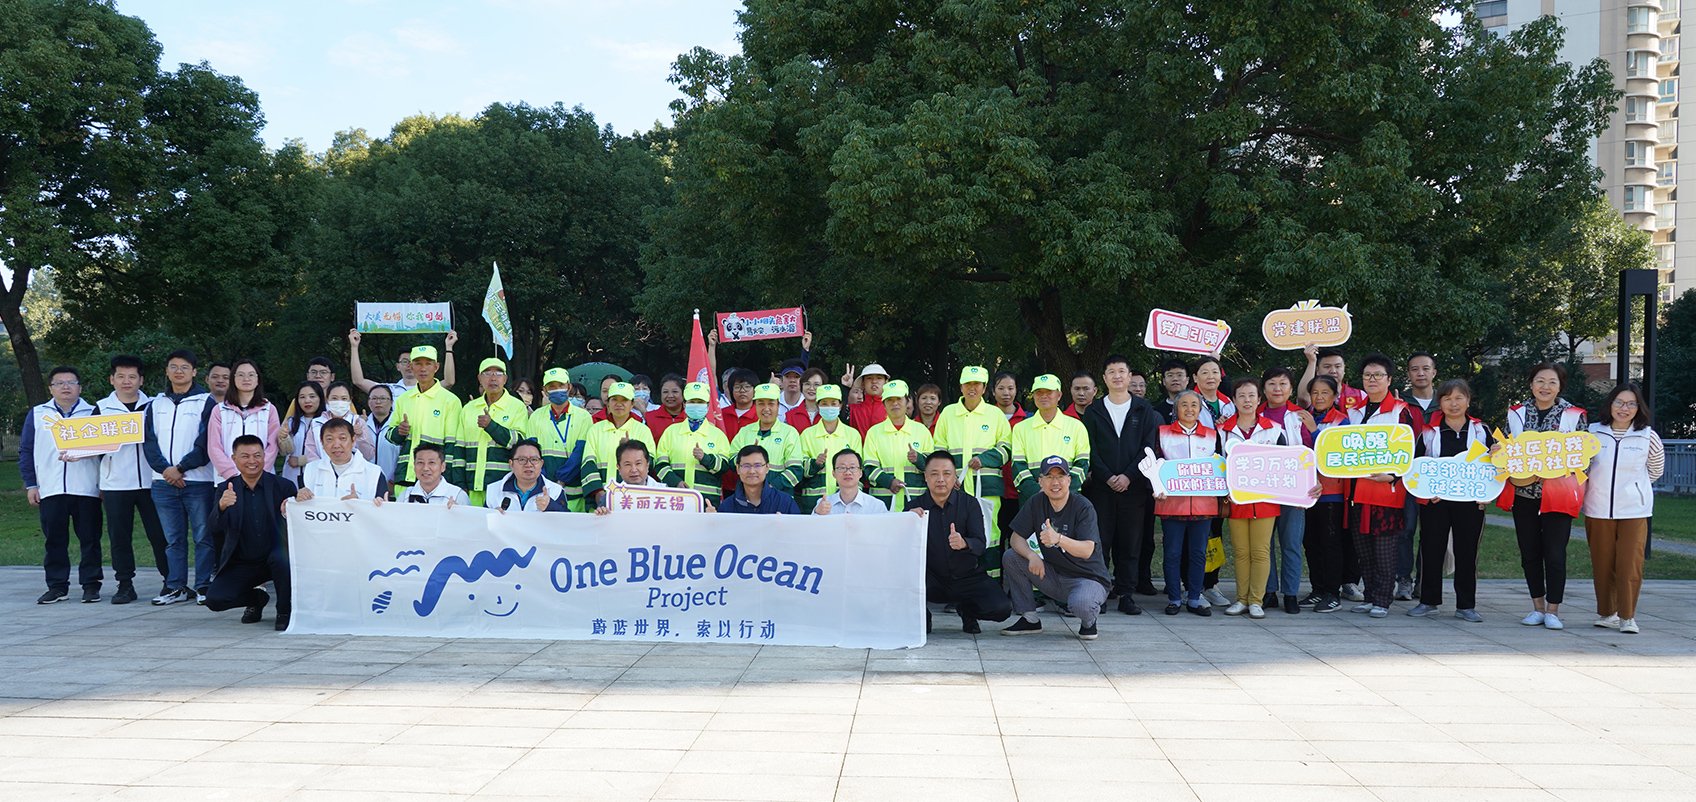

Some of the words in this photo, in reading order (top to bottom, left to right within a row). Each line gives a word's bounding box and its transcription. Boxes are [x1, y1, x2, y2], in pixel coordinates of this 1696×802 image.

[1160, 319, 1219, 347] 党建引领
[1272, 317, 1342, 338] 党建联盟
[59, 419, 139, 441] 社企联动
[1342, 431, 1388, 450] 唤醒
[1505, 436, 1584, 458] 社区为我
[1235, 456, 1300, 472] 学习万物
[1326, 450, 1410, 467] 居民行动力
[1506, 452, 1584, 474] 我为社区
[1177, 462, 1214, 477] 你也是
[1420, 461, 1497, 481] 睦邻讲师
[1167, 477, 1227, 492] 小区的主角
[1237, 473, 1298, 489] Re-计划
[1428, 479, 1486, 498] 诞生记
[619, 495, 685, 511] 美丽无锡
[304, 510, 354, 522] SONY
[550, 557, 618, 593] One
[626, 545, 707, 583] Blue
[714, 543, 824, 595] Ocean
[646, 586, 728, 612] Project
